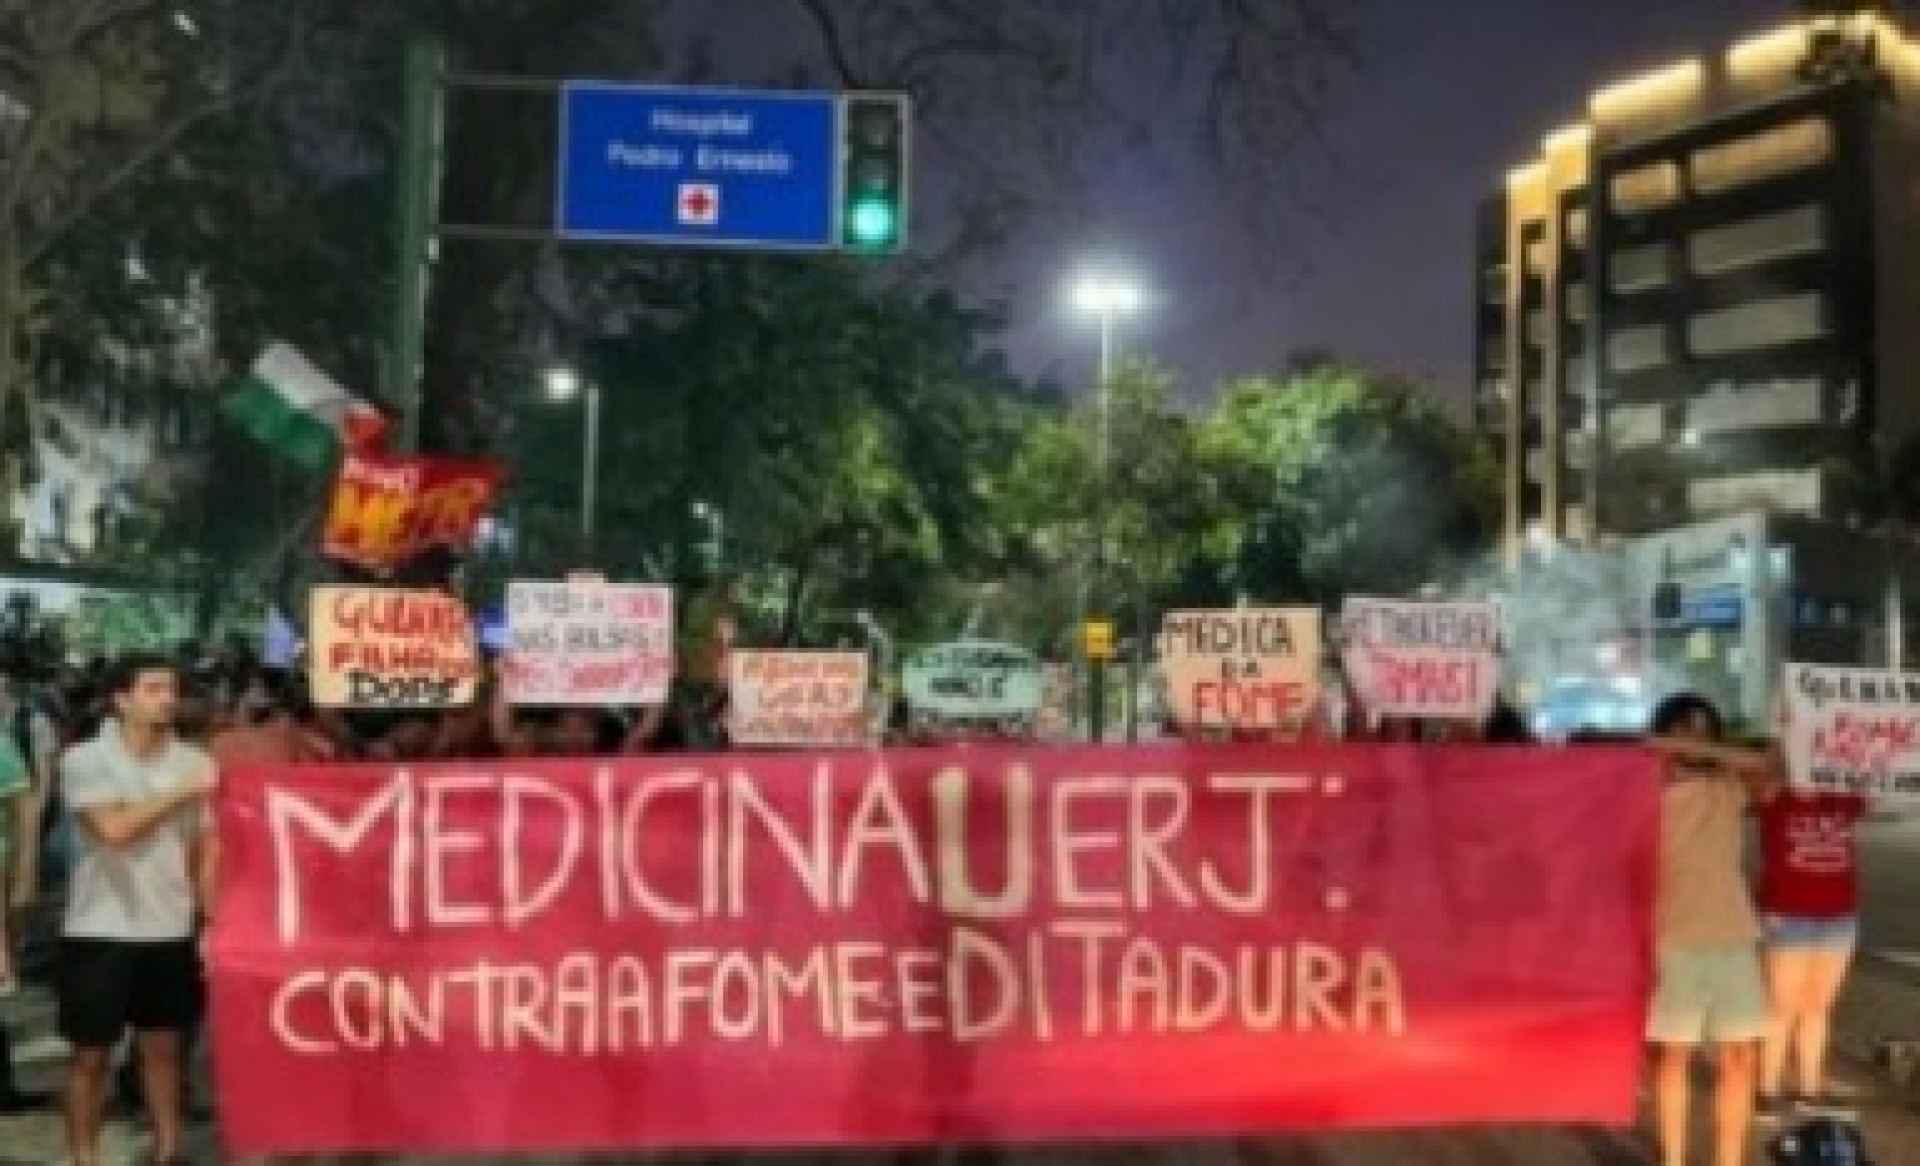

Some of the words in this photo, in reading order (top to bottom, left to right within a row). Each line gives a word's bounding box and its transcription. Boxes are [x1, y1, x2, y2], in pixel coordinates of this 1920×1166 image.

[263, 763, 930, 947] MEDICINA
[269, 950, 598, 1055] CONTRA
[663, 942, 889, 1047] FOME
[946, 920, 1406, 1042] DITADURA
